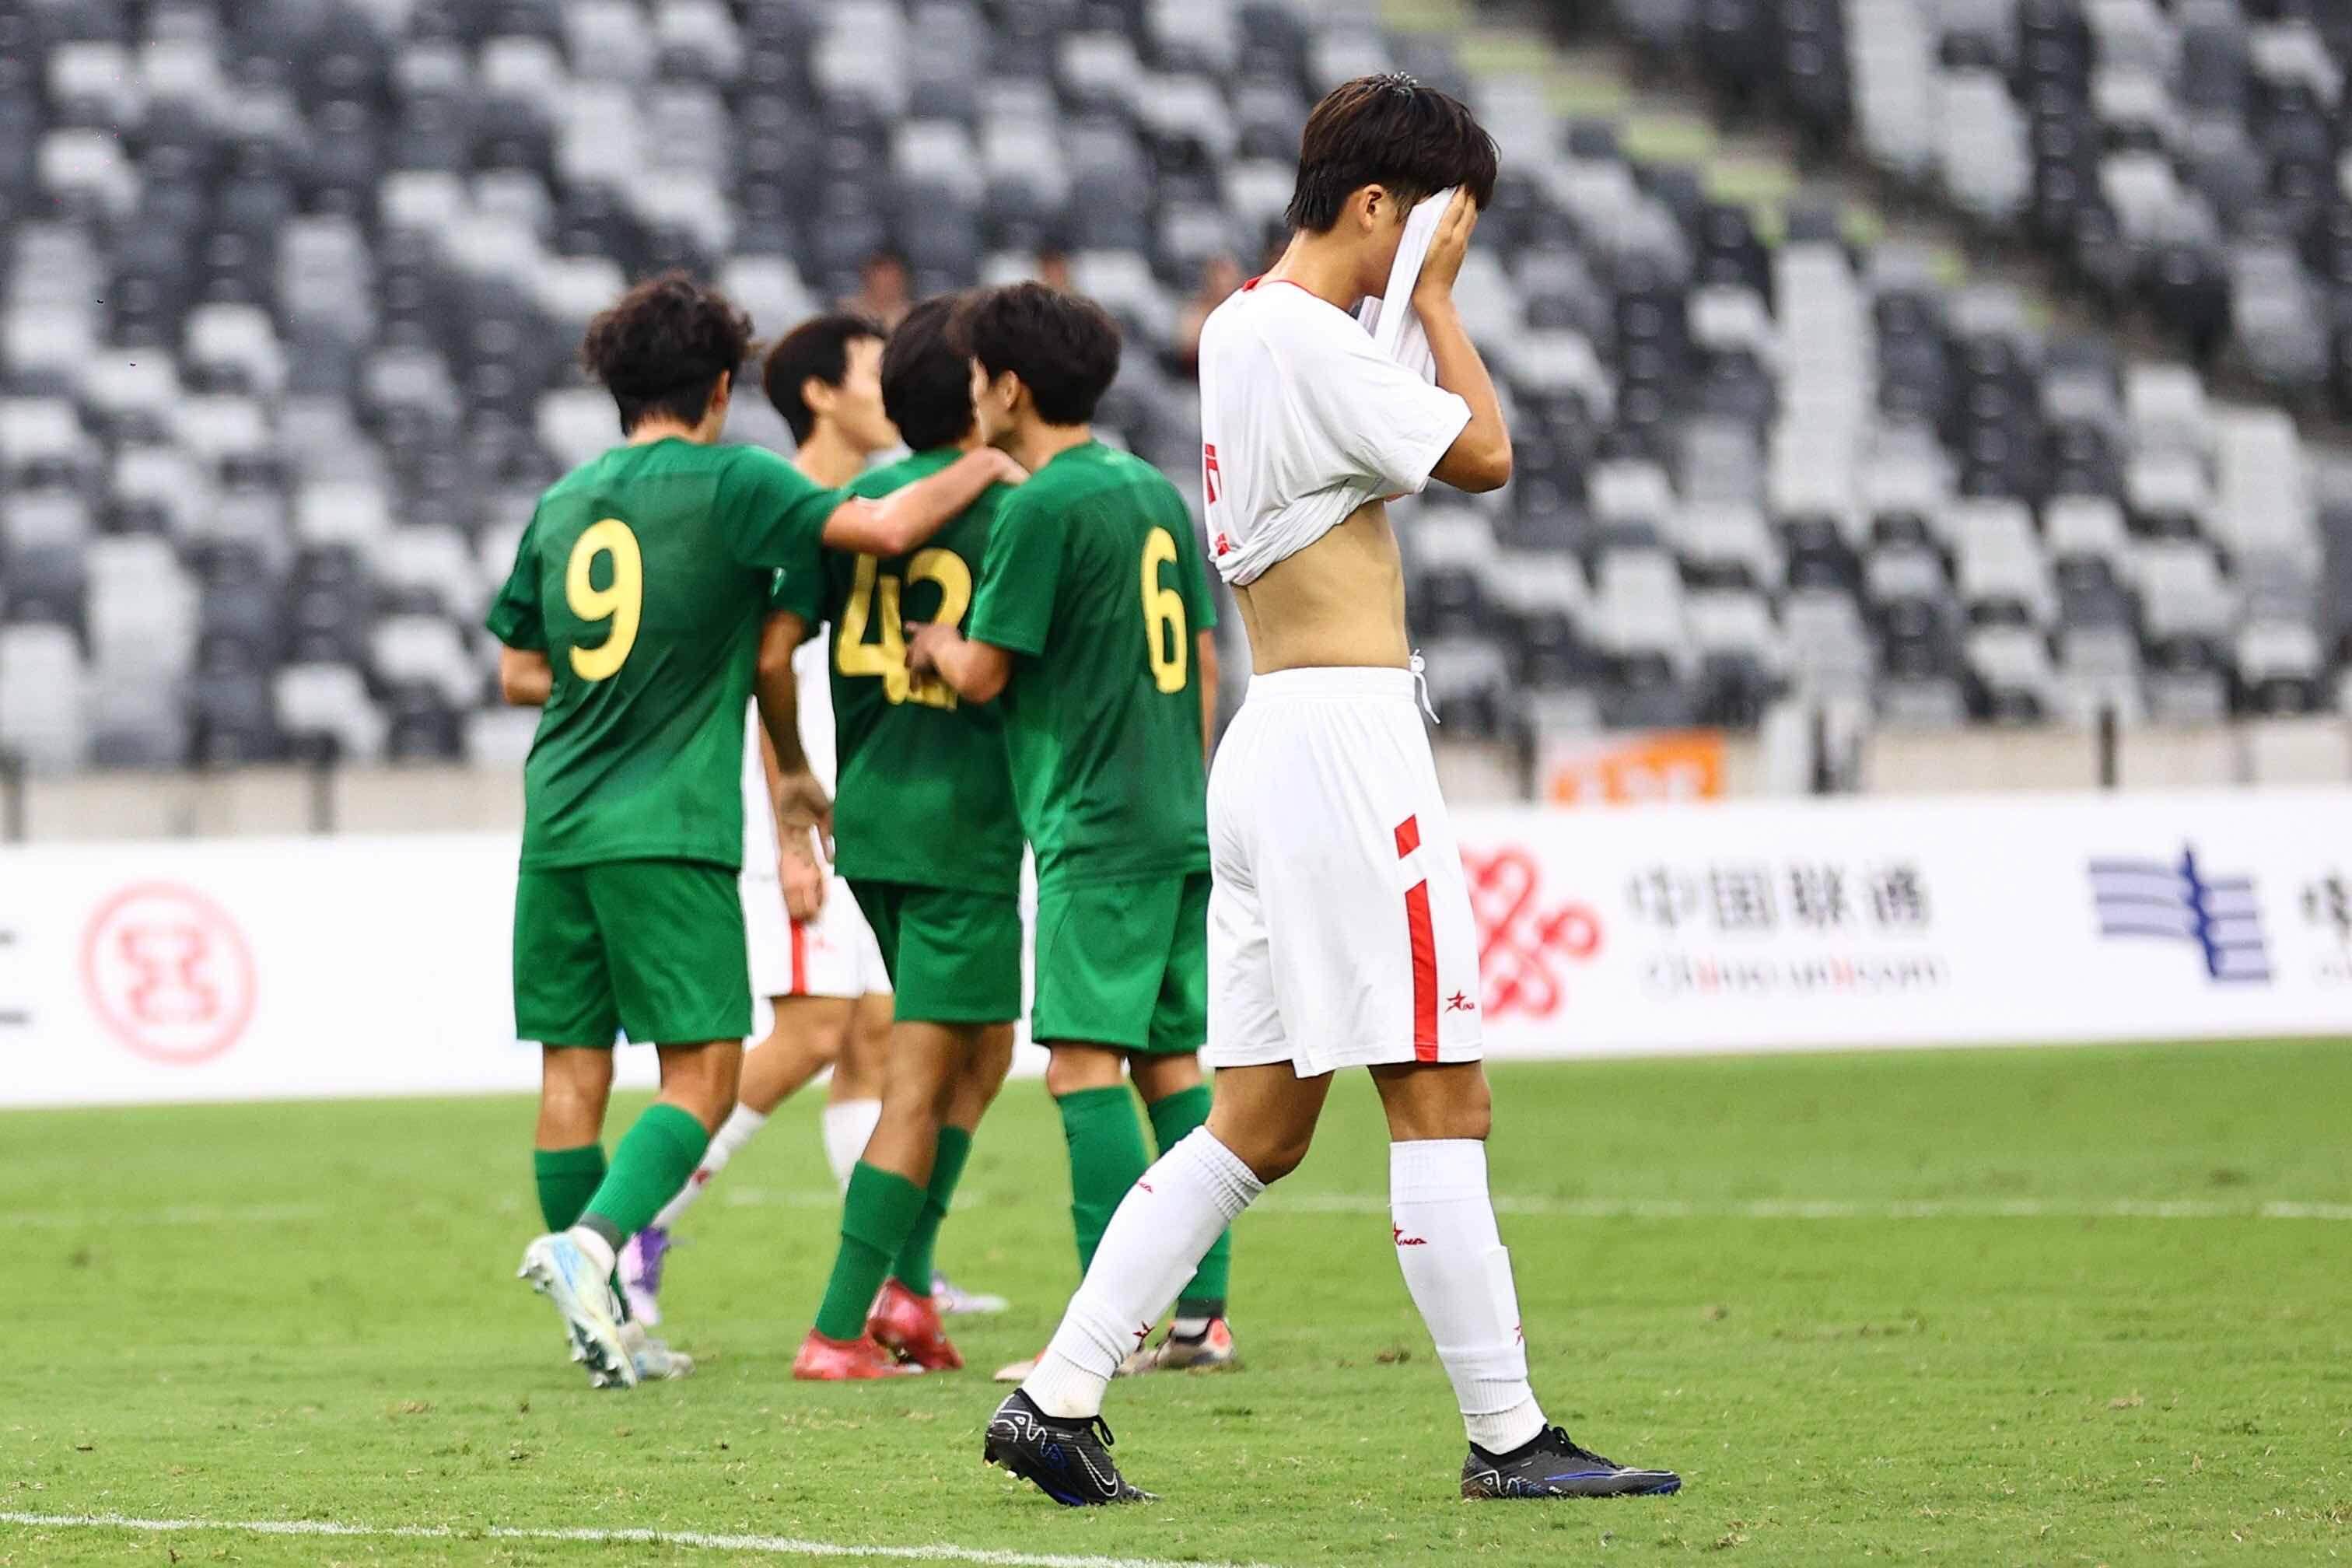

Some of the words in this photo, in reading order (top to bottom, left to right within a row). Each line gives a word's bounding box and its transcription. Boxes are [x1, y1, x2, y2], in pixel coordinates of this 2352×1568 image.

[565, 518, 643, 681] 9
[837, 545, 972, 710] 42
[1140, 525, 1188, 695] 6
[1627, 860, 1934, 933] 中国联通
